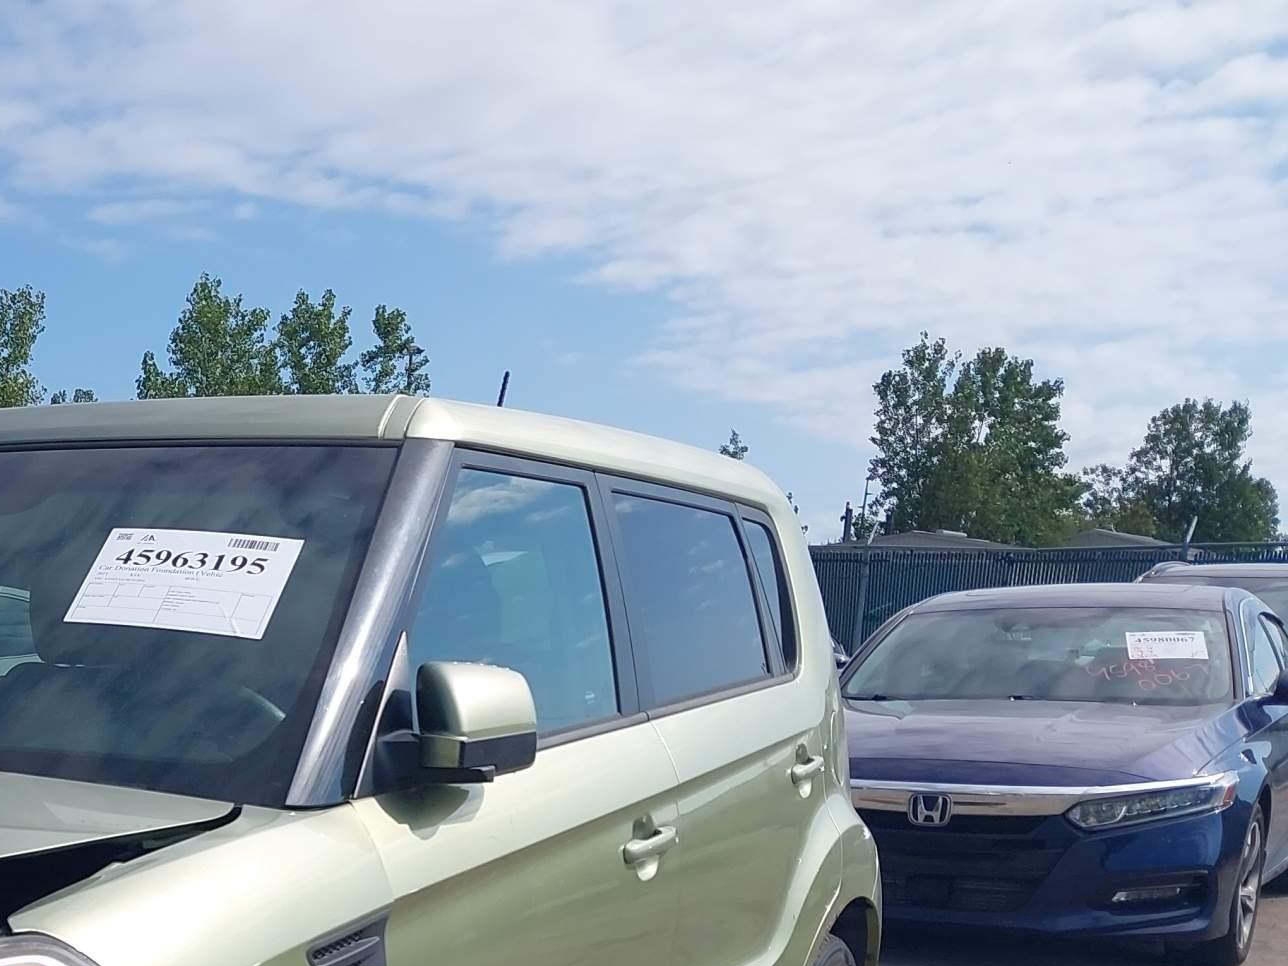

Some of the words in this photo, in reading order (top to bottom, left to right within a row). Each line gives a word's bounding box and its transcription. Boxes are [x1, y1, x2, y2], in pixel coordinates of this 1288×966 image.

[114, 565, 150, 573] Donation
[151, 567, 194, 576] Foundation
[115, 548, 269, 575] 45963195
